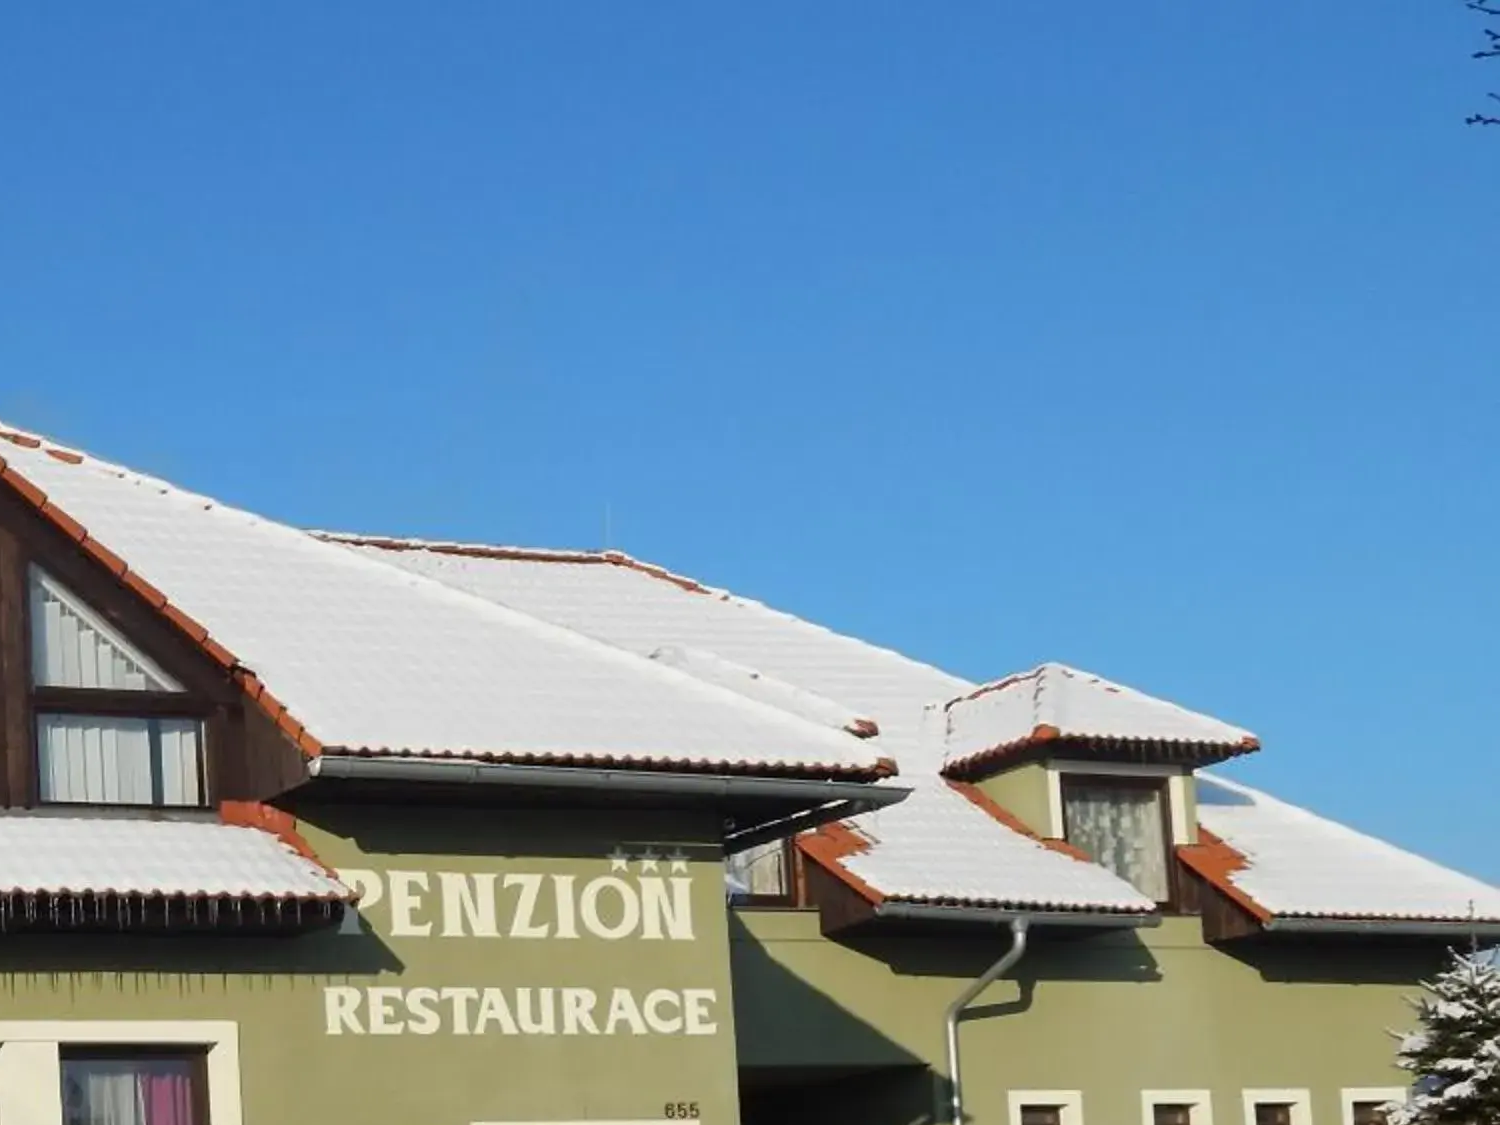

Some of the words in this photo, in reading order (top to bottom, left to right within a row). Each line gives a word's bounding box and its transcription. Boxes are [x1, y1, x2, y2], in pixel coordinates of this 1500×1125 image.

[335, 868, 695, 940] PENZION
[324, 986, 718, 1035] RESTAURACE
[665, 1102, 700, 1119] 655
